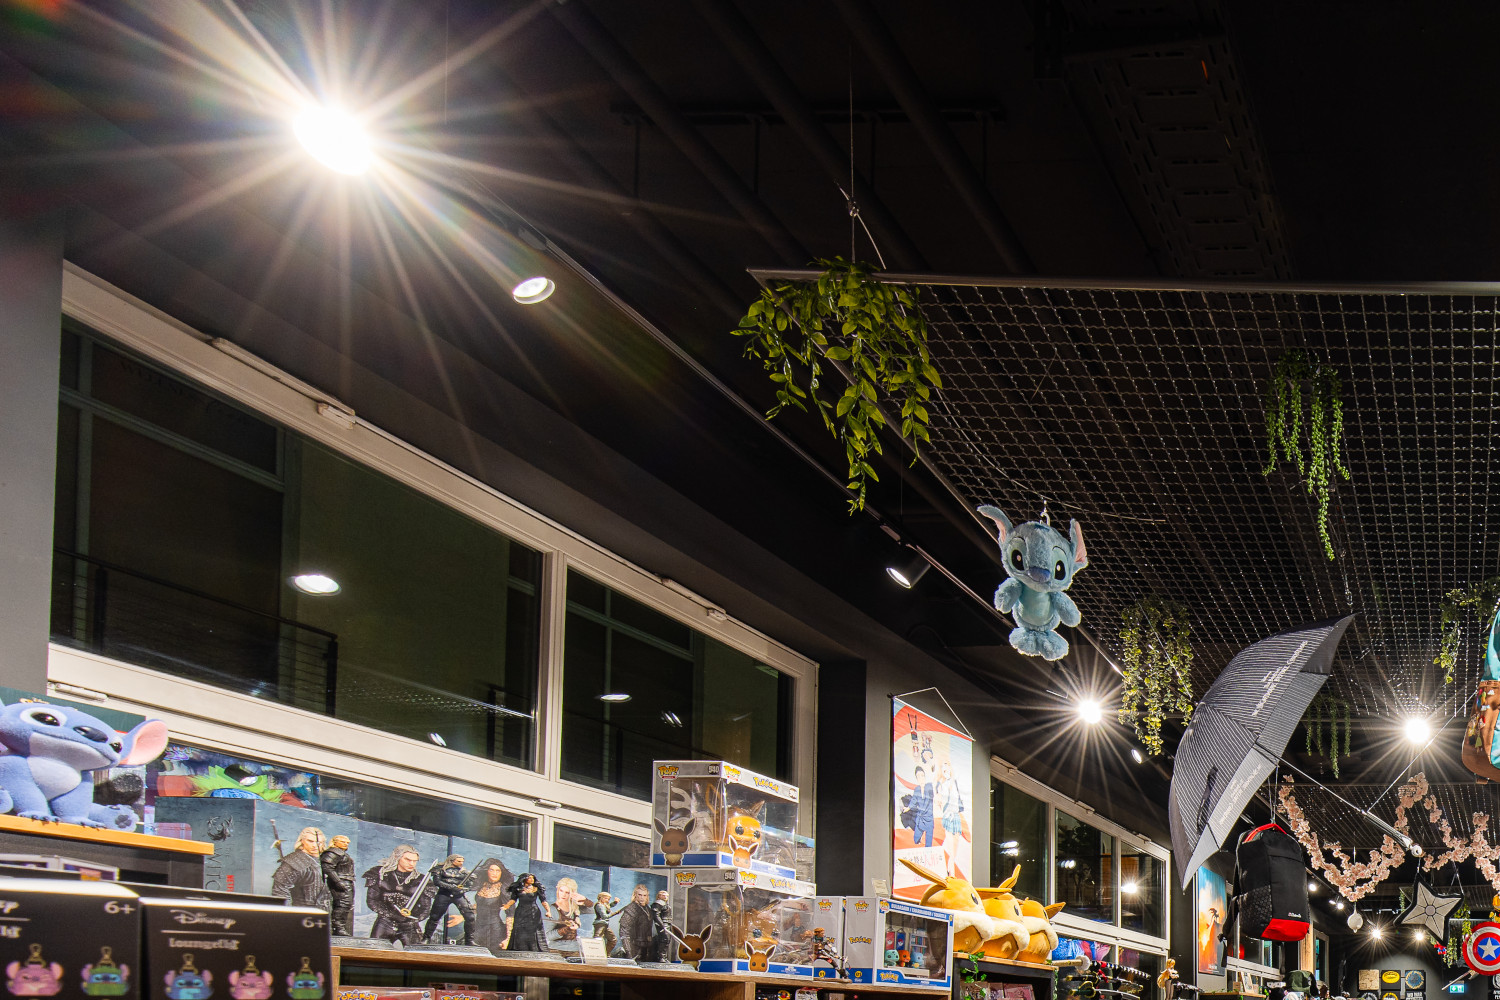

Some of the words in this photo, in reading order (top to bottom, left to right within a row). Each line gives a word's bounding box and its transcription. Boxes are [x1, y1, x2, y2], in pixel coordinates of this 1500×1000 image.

[658, 766, 679, 777] POP!
[709, 765, 719, 774] 540
[676, 872, 696, 882] POP!
[724, 872, 735, 880] 540
[104, 901, 135, 914] 6+
[169, 909, 237, 929] Disney
[302, 917, 327, 928] 6+
